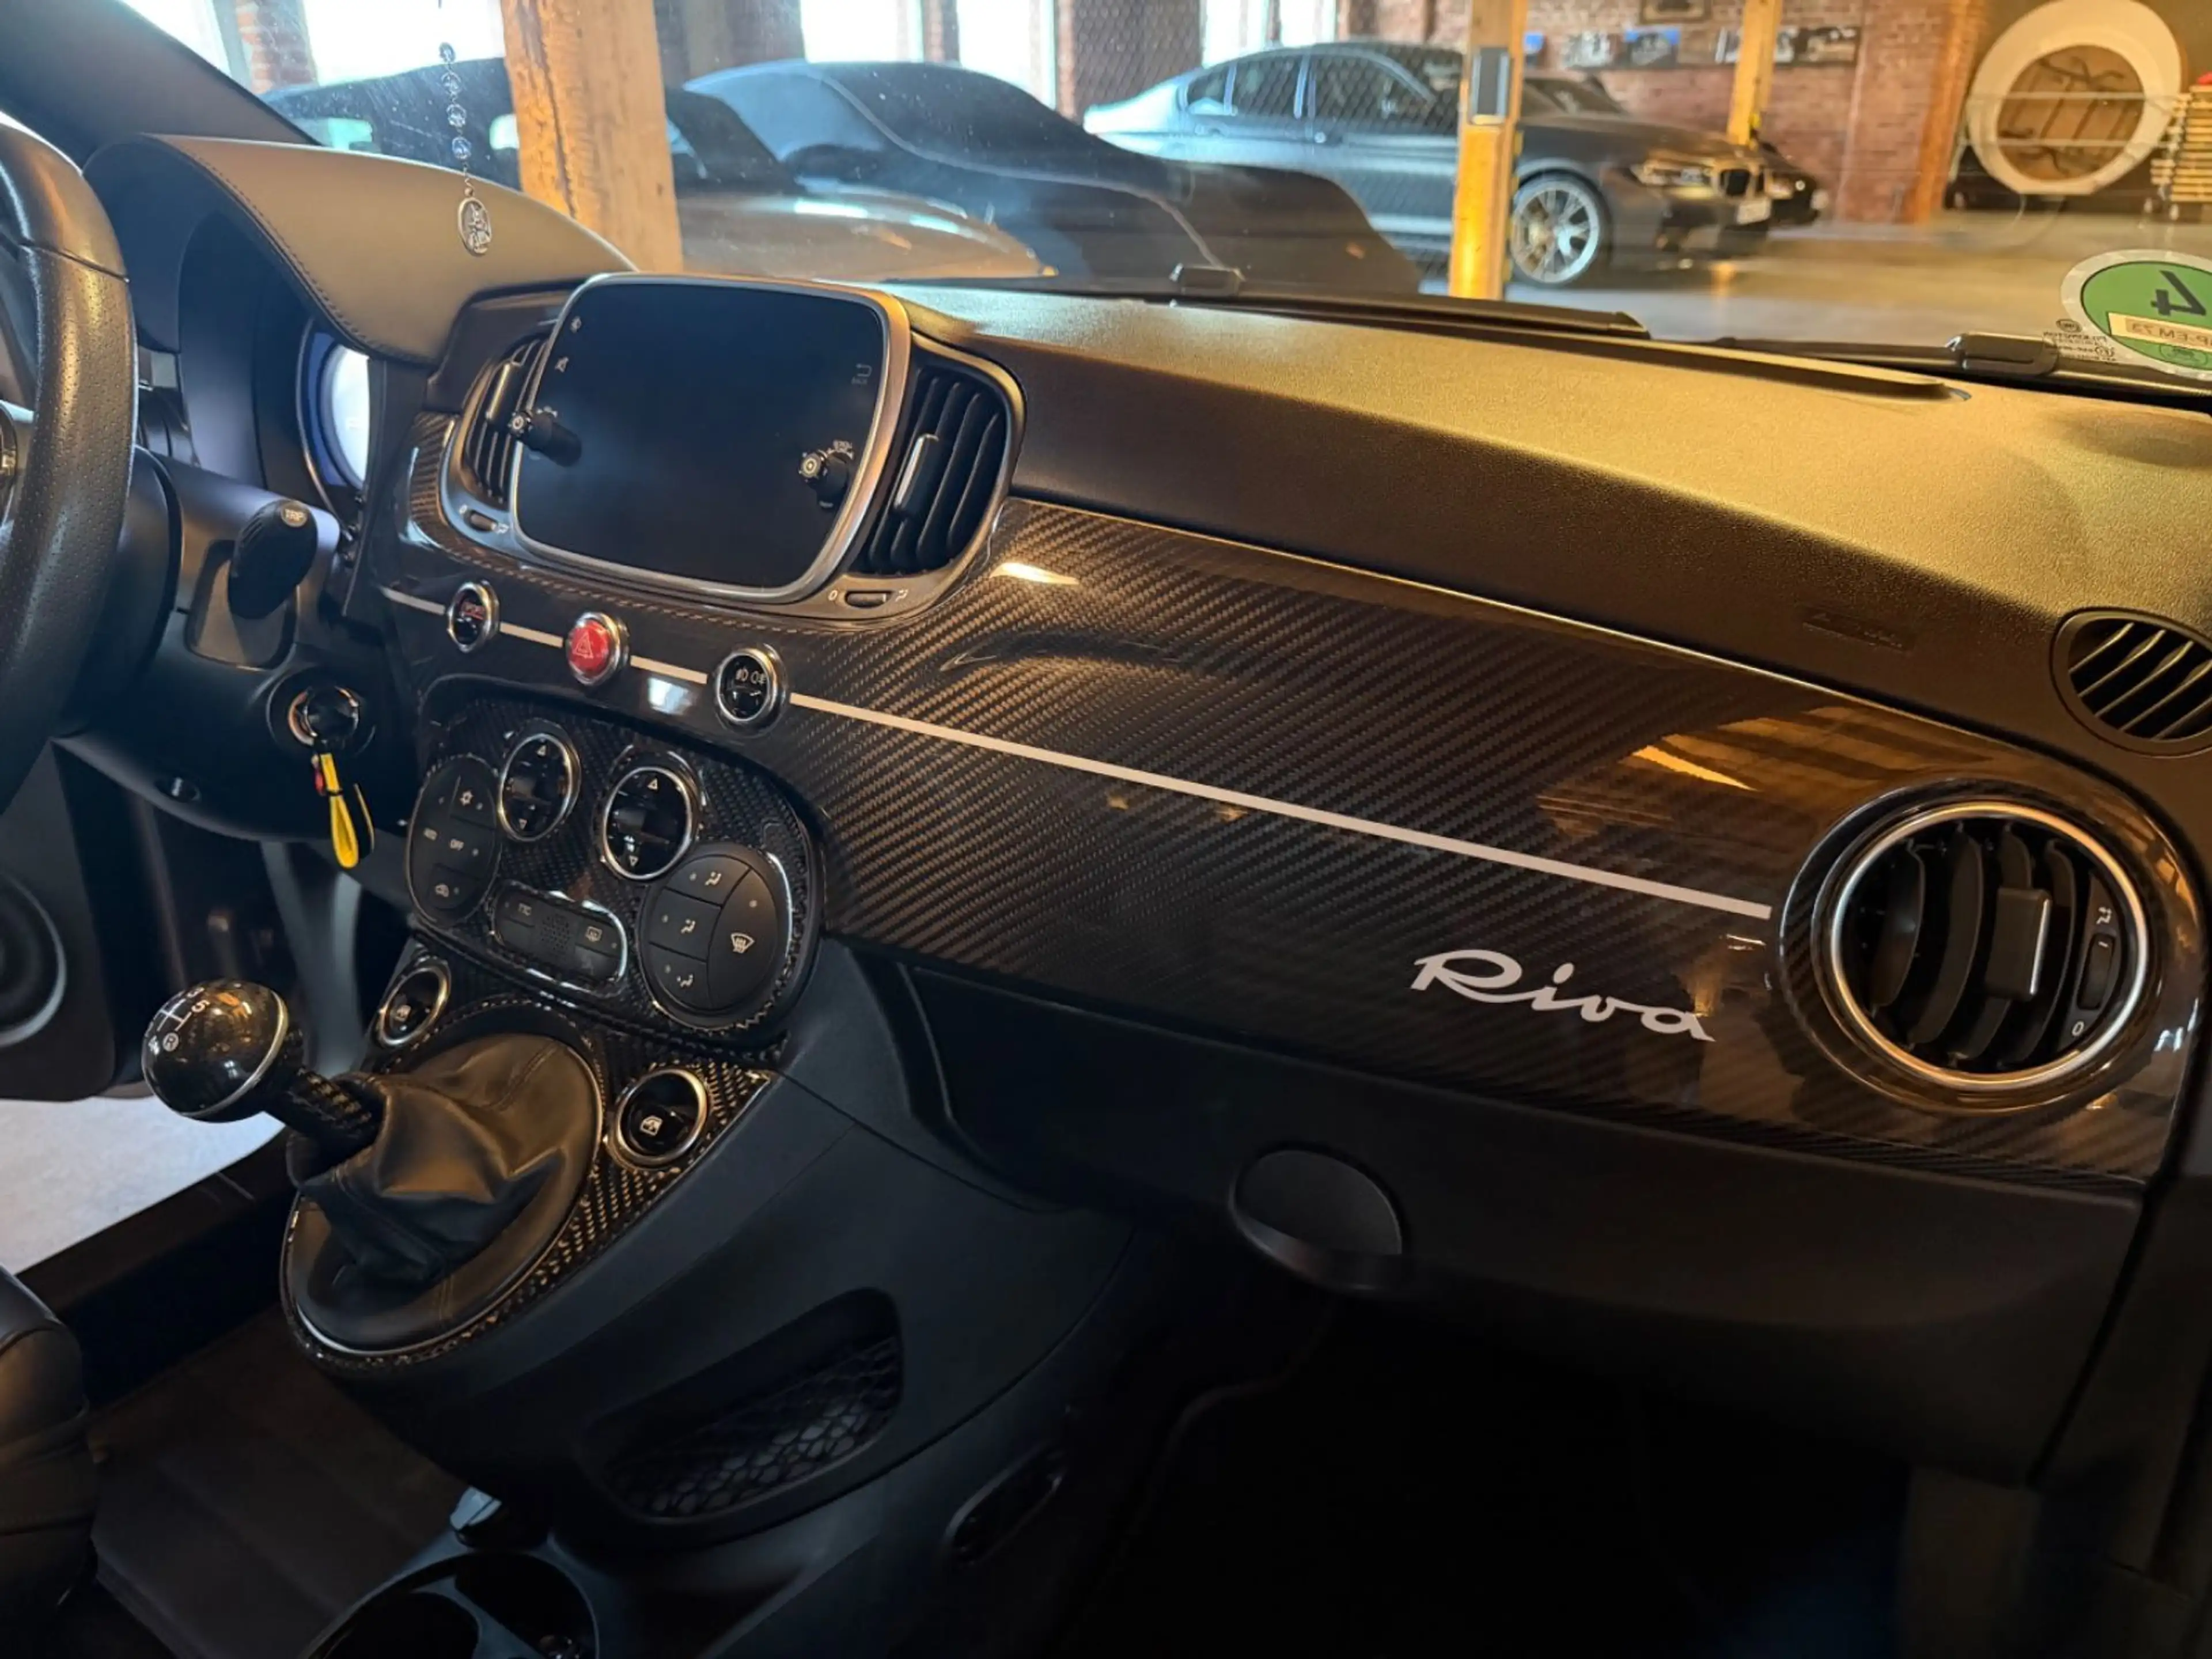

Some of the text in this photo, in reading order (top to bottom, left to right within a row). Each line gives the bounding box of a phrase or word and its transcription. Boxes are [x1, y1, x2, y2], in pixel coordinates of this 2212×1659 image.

[285, 509, 304, 521] TRIP
[1410, 949, 1716, 1043] Riva
[191, 999, 211, 1013] 5
